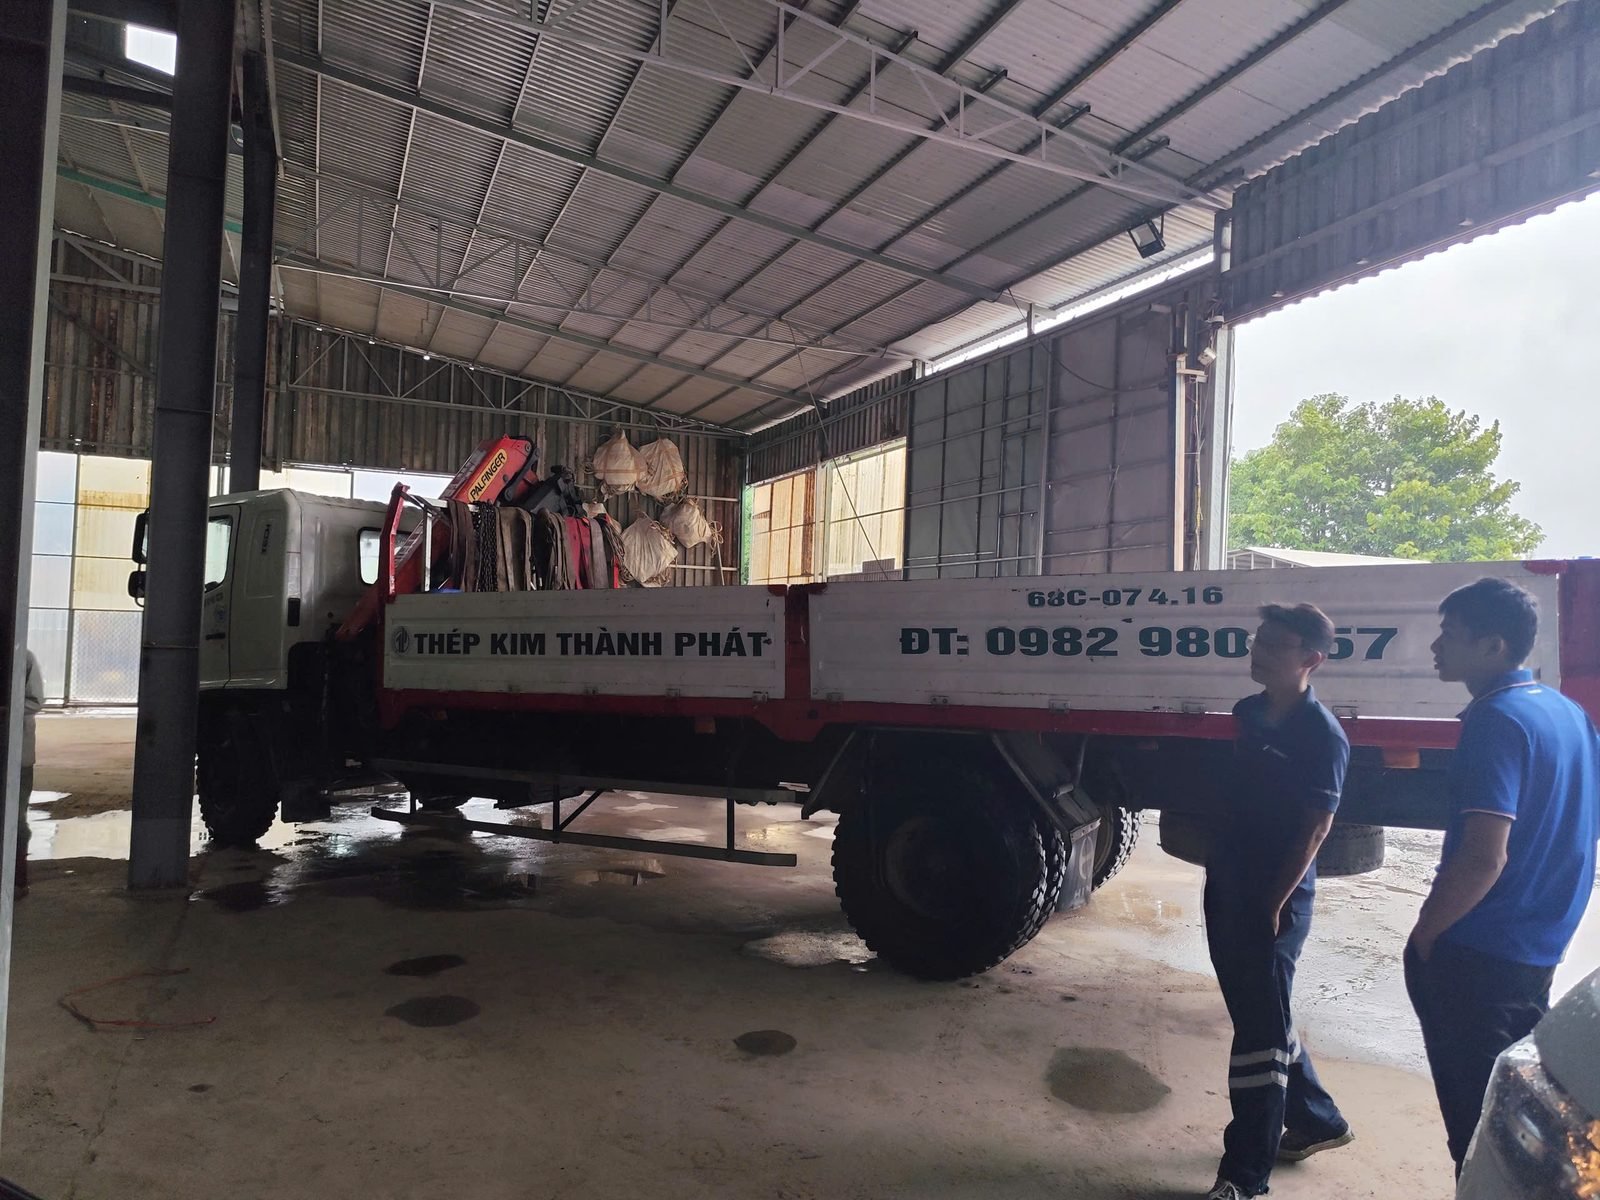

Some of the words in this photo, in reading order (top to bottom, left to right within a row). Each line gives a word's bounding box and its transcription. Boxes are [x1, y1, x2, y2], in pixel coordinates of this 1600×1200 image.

[469, 451, 506, 500] PALFINGER
[1027, 586, 1224, 608] 68C-074.16
[413, 628, 481, 655] THÉP
[490, 632, 546, 656] KIM
[556, 626, 662, 656] THÀNH
[674, 626, 767, 657] PHÁT
[899, 627, 969, 656] ĐT:
[985, 626, 1119, 657] 0982
[1139, 627, 1250, 658] 980
[1326, 627, 1398, 660] 57
